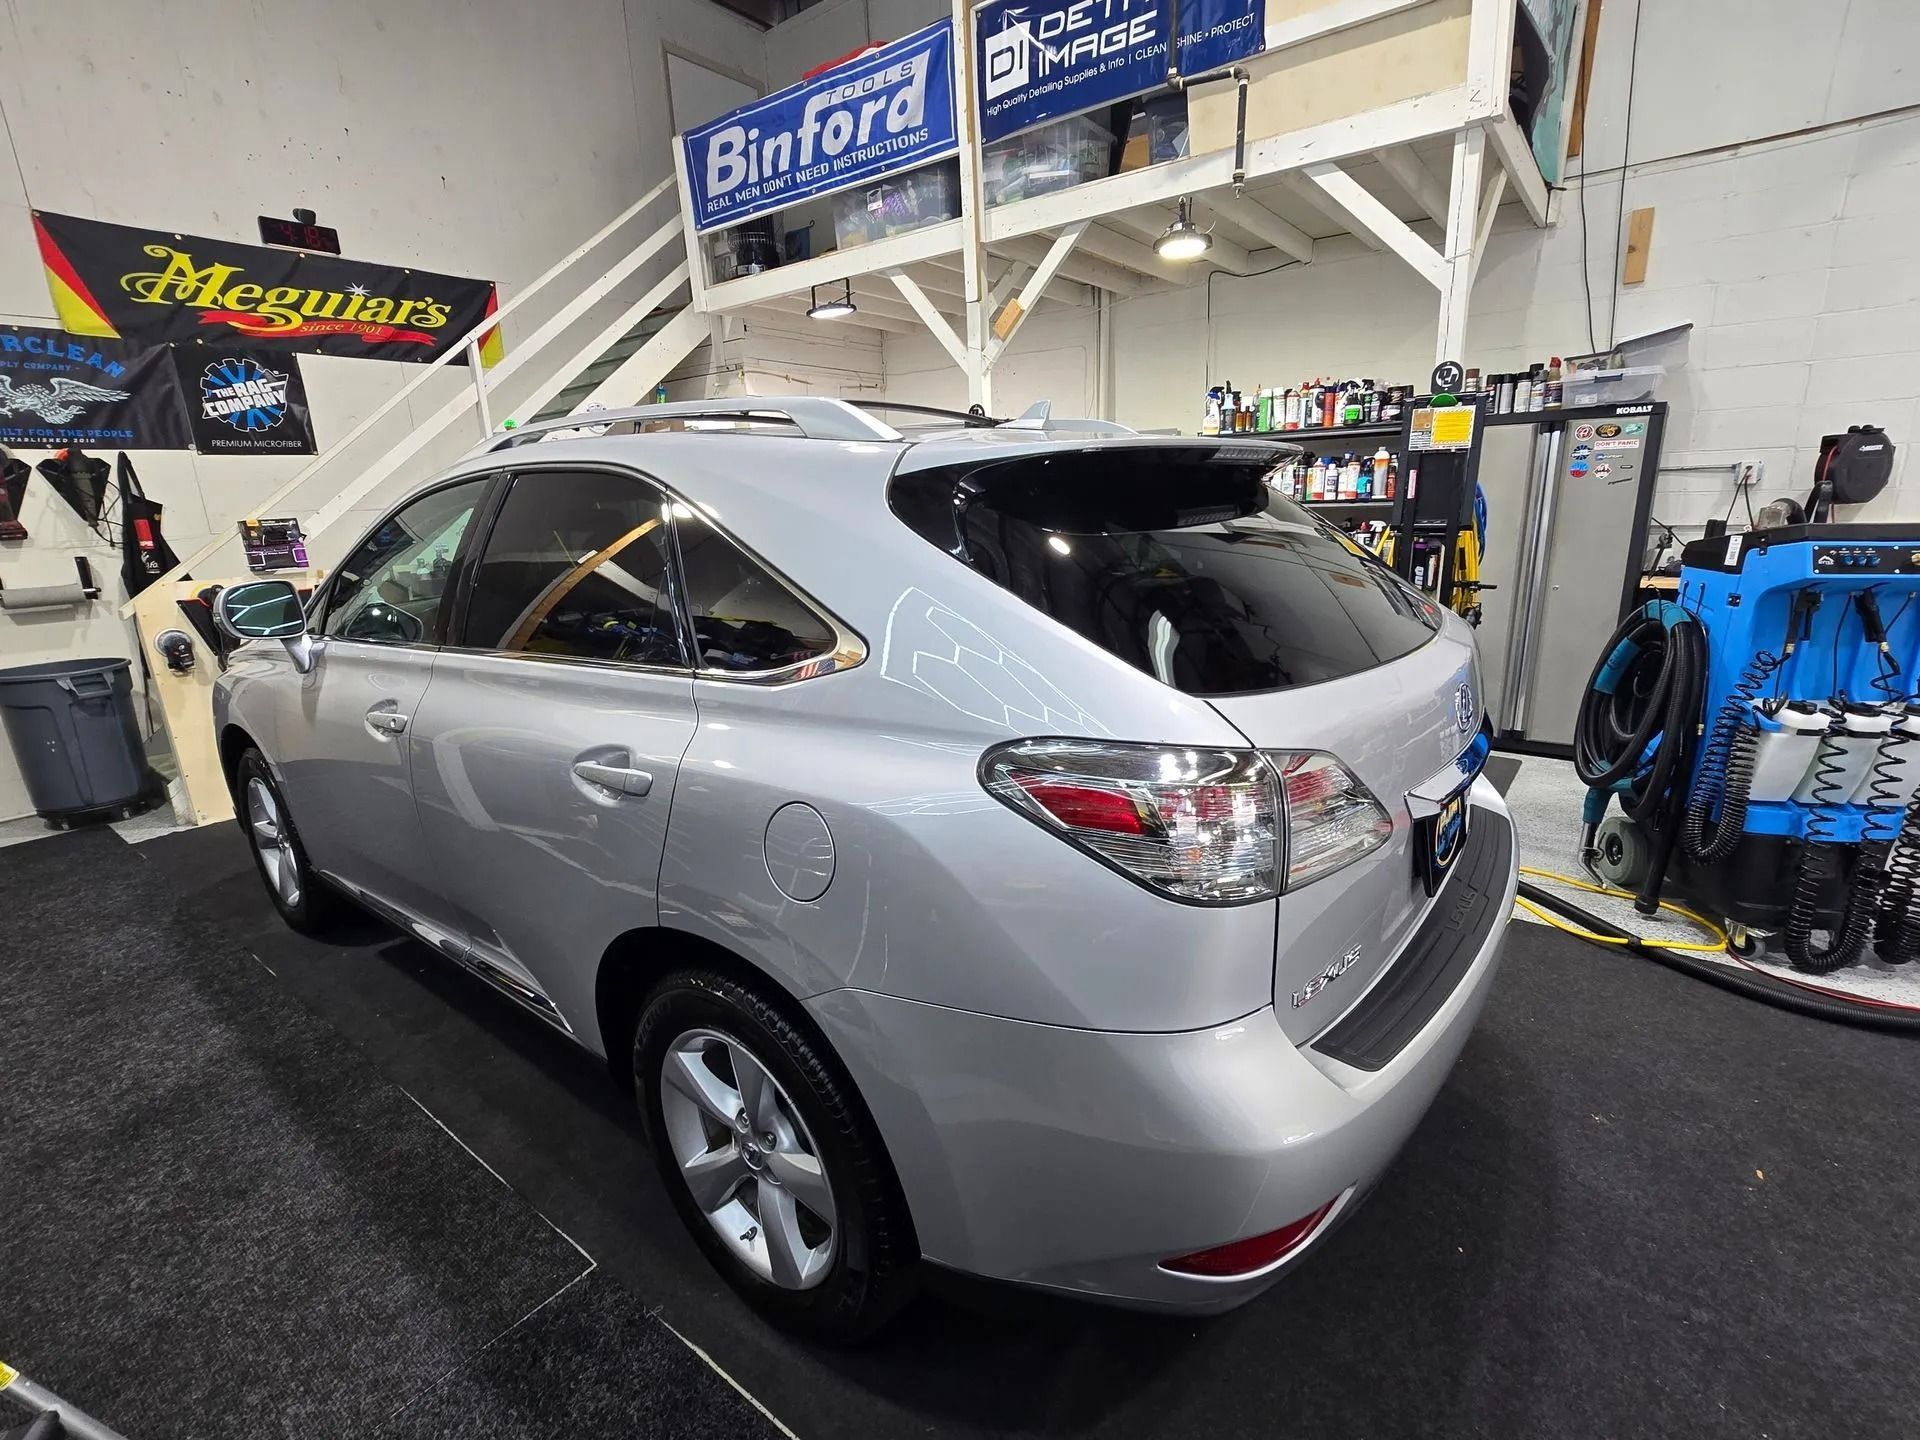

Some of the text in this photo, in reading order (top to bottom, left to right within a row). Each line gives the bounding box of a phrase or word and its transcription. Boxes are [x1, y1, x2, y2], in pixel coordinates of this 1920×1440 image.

[1039, 0, 1150, 40] DET
[990, 39, 1024, 83] DI
[1039, 10, 1158, 78] IMAGE
[826, 61, 914, 104] TOOLS
[986, 104, 1002, 117] High
[1003, 92, 1028, 109] Quality
[1029, 80, 1063, 99] Detailing
[1064, 68, 1098, 86] Supplies
[1100, 62, 1106, 72] &
[1108, 57, 1125, 70] Info
[1135, 42, 1167, 61] CLEAN
[1211, 13, 1255, 38] PROTECT
[707, 48, 931, 198] Binford
[707, 128, 929, 213] REAL MEN DON'T NEED INSTRUCTIONS
[120, 245, 451, 332] Meguiar's
[299, 322, 385, 335] since 1901
[23, 362, 71, 371] COMPANY
[204, 389, 285, 417] COMPANY
[212, 378, 286, 398] THE RAG
[1616, 405, 1653, 414] KOBALT
[0, 428, 134, 438] ILT FOR THE PEOPLE
[211, 439, 303, 448] PREMIUM MICROFIBER
[1292, 943, 1361, 1009] LEXUS
